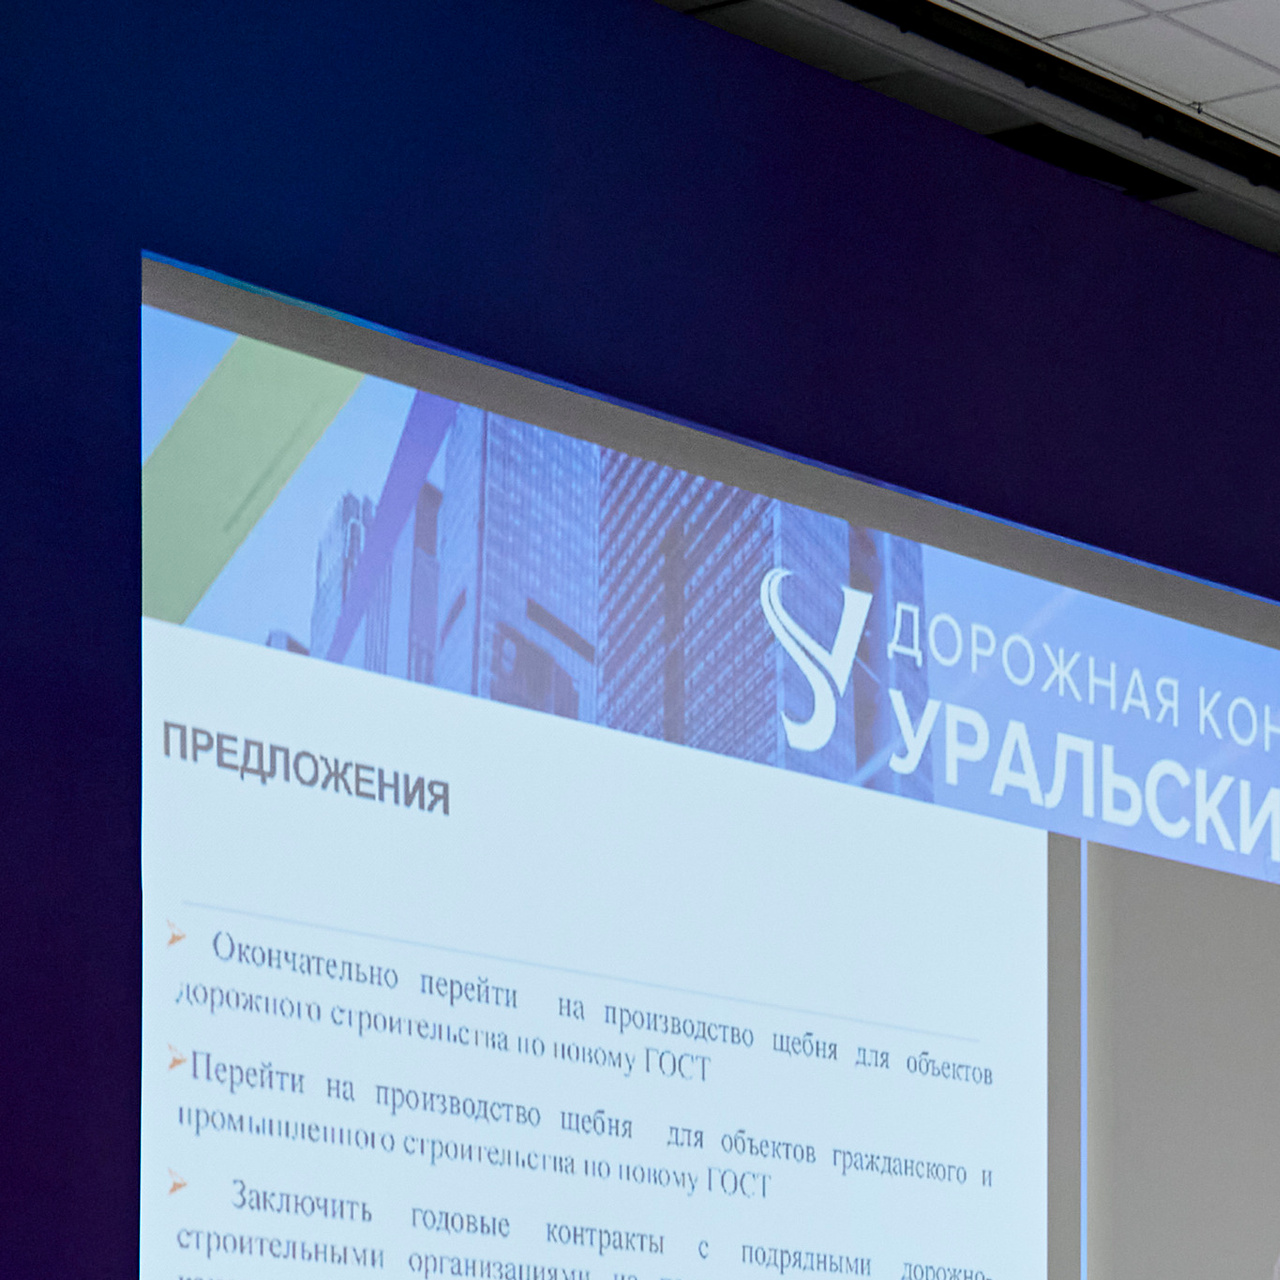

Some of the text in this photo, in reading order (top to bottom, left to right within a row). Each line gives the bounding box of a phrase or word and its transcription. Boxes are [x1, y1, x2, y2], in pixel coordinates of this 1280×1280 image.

[887, 600, 1179, 728] ДОРОЖНАЯ
[162, 720, 450, 815] ПРЕДЛОЖЕНИЯ
[175, 981, 711, 1082] дорожного строительства по новому ГОСТ
[213, 930, 993, 1085] Окончательно перейти на производство щебня для объектов
[178, 1105, 771, 1199] промышленного строительства по новому ГОСТ
[191, 1050, 992, 1187] Перейти на производство щебня для объектов гражданского и
[177, 1228, 385, 1269] строительными
[232, 1179, 373, 1223] Заключить
[411, 1206, 510, 1238] годовые
[546, 1221, 664, 1255] контракты
[698, 1239, 709, 1259] с
[741, 1242, 871, 1277] подрядными
